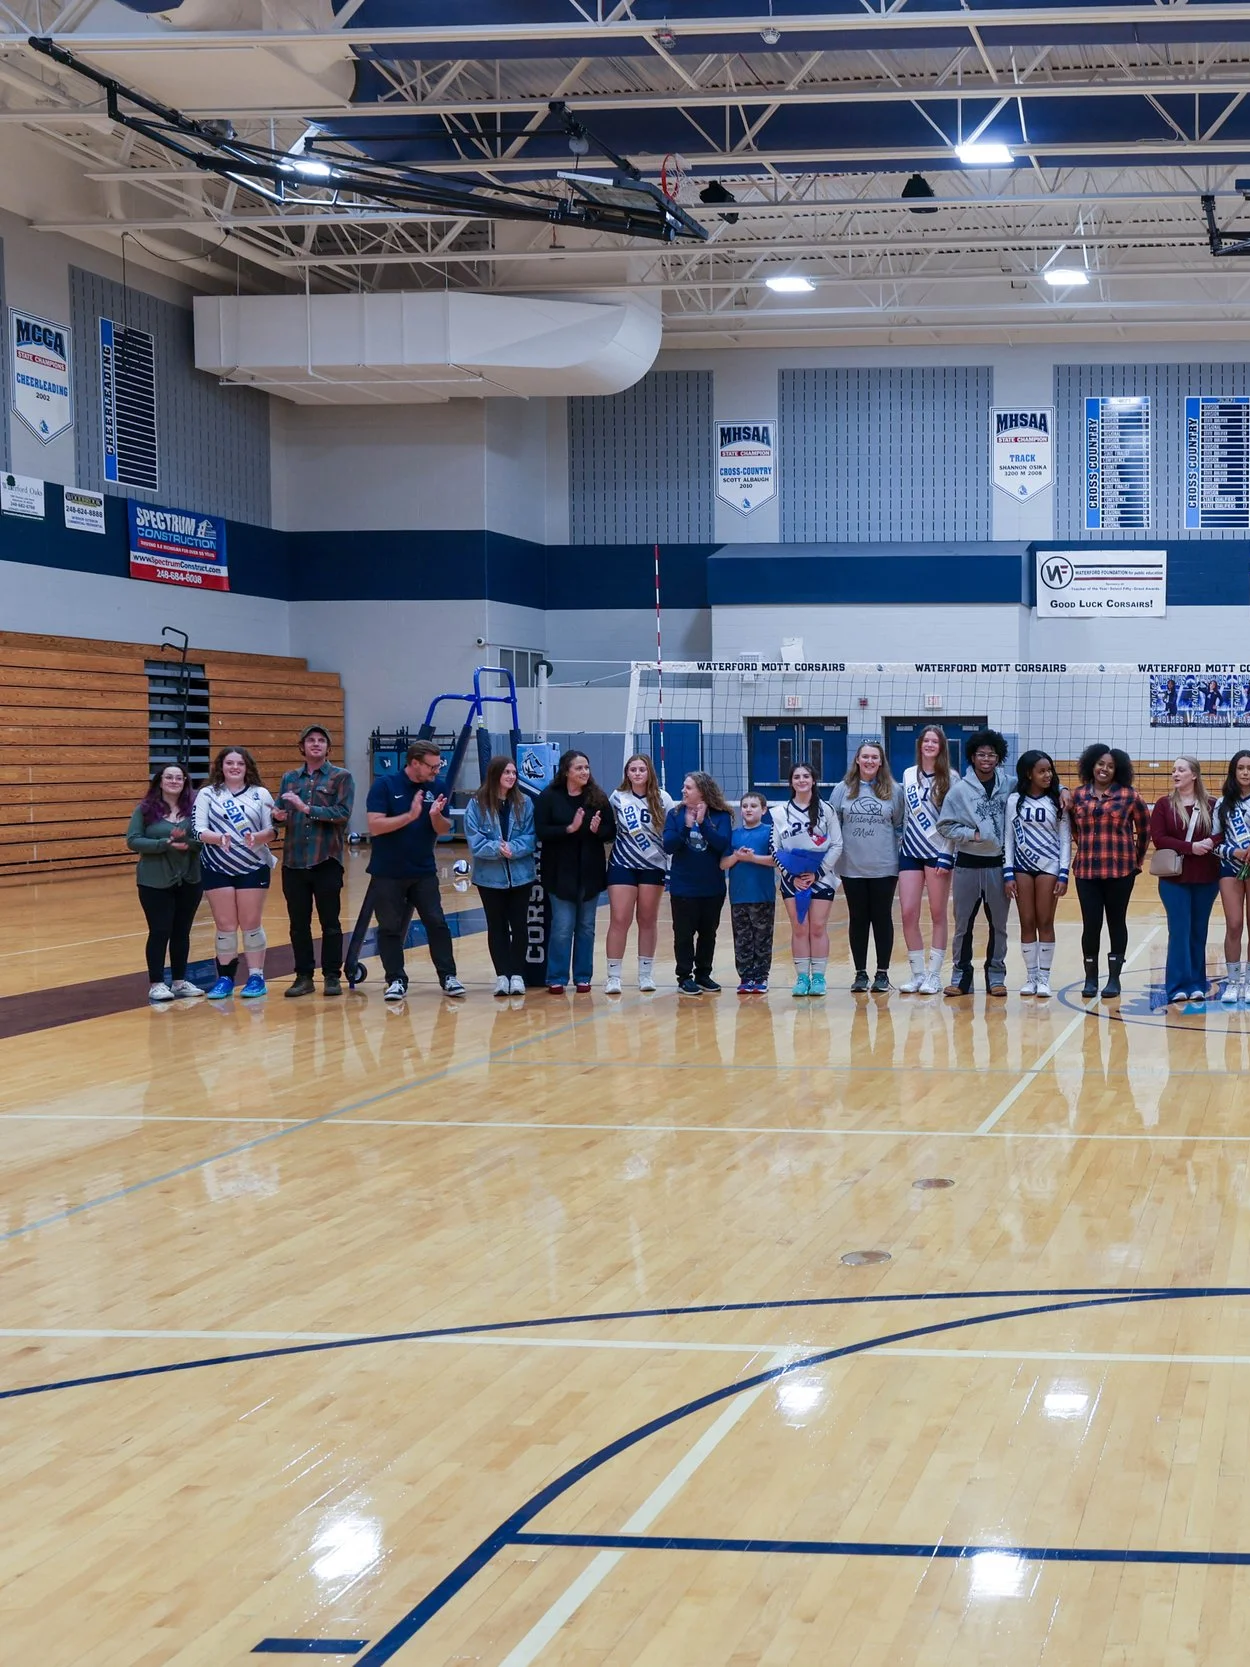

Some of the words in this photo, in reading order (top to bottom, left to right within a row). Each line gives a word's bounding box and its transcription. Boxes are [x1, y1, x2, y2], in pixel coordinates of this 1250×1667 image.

[16, 318, 66, 362] MCCA
[18, 350, 34, 361] STATE
[34, 355, 65, 371] CHAMPIONS
[16, 372, 68, 397] CHEERLEADING
[36, 392, 50, 401] 2002
[102, 344, 116, 456] CHEERLEADING
[996, 413, 1049, 436] MHSAA
[720, 426, 771, 449] MHSAA
[1088, 419, 1098, 469] COUNTRY
[1187, 418, 1198, 469] COUNTRY
[1009, 454, 1036, 462] TRACK
[720, 467, 772, 476] CROSS-COUNTRY
[1088, 473, 1098, 509] CROSS
[1187, 473, 1197, 509] CROSS
[136, 506, 196, 536] SPECTRUM
[137, 527, 217, 549] CONSTRUCTION
[697, 662, 757, 671] WATERFORD
[761, 662, 790, 671] MOTT
[794, 663, 845, 671] CORSAIRS
[915, 664, 977, 672] WATERFORD
[981, 664, 1010, 672] MOTT
[1015, 664, 1067, 672] CORSAIRS
[1138, 664, 1200, 673] WATERFORD
[1205, 664, 1235, 673] MOTT
[640, 808, 651, 823] 6
[848, 815, 888, 825] Waterford
[1024, 807, 1046, 823] 10
[852, 827, 875, 838] Mott
